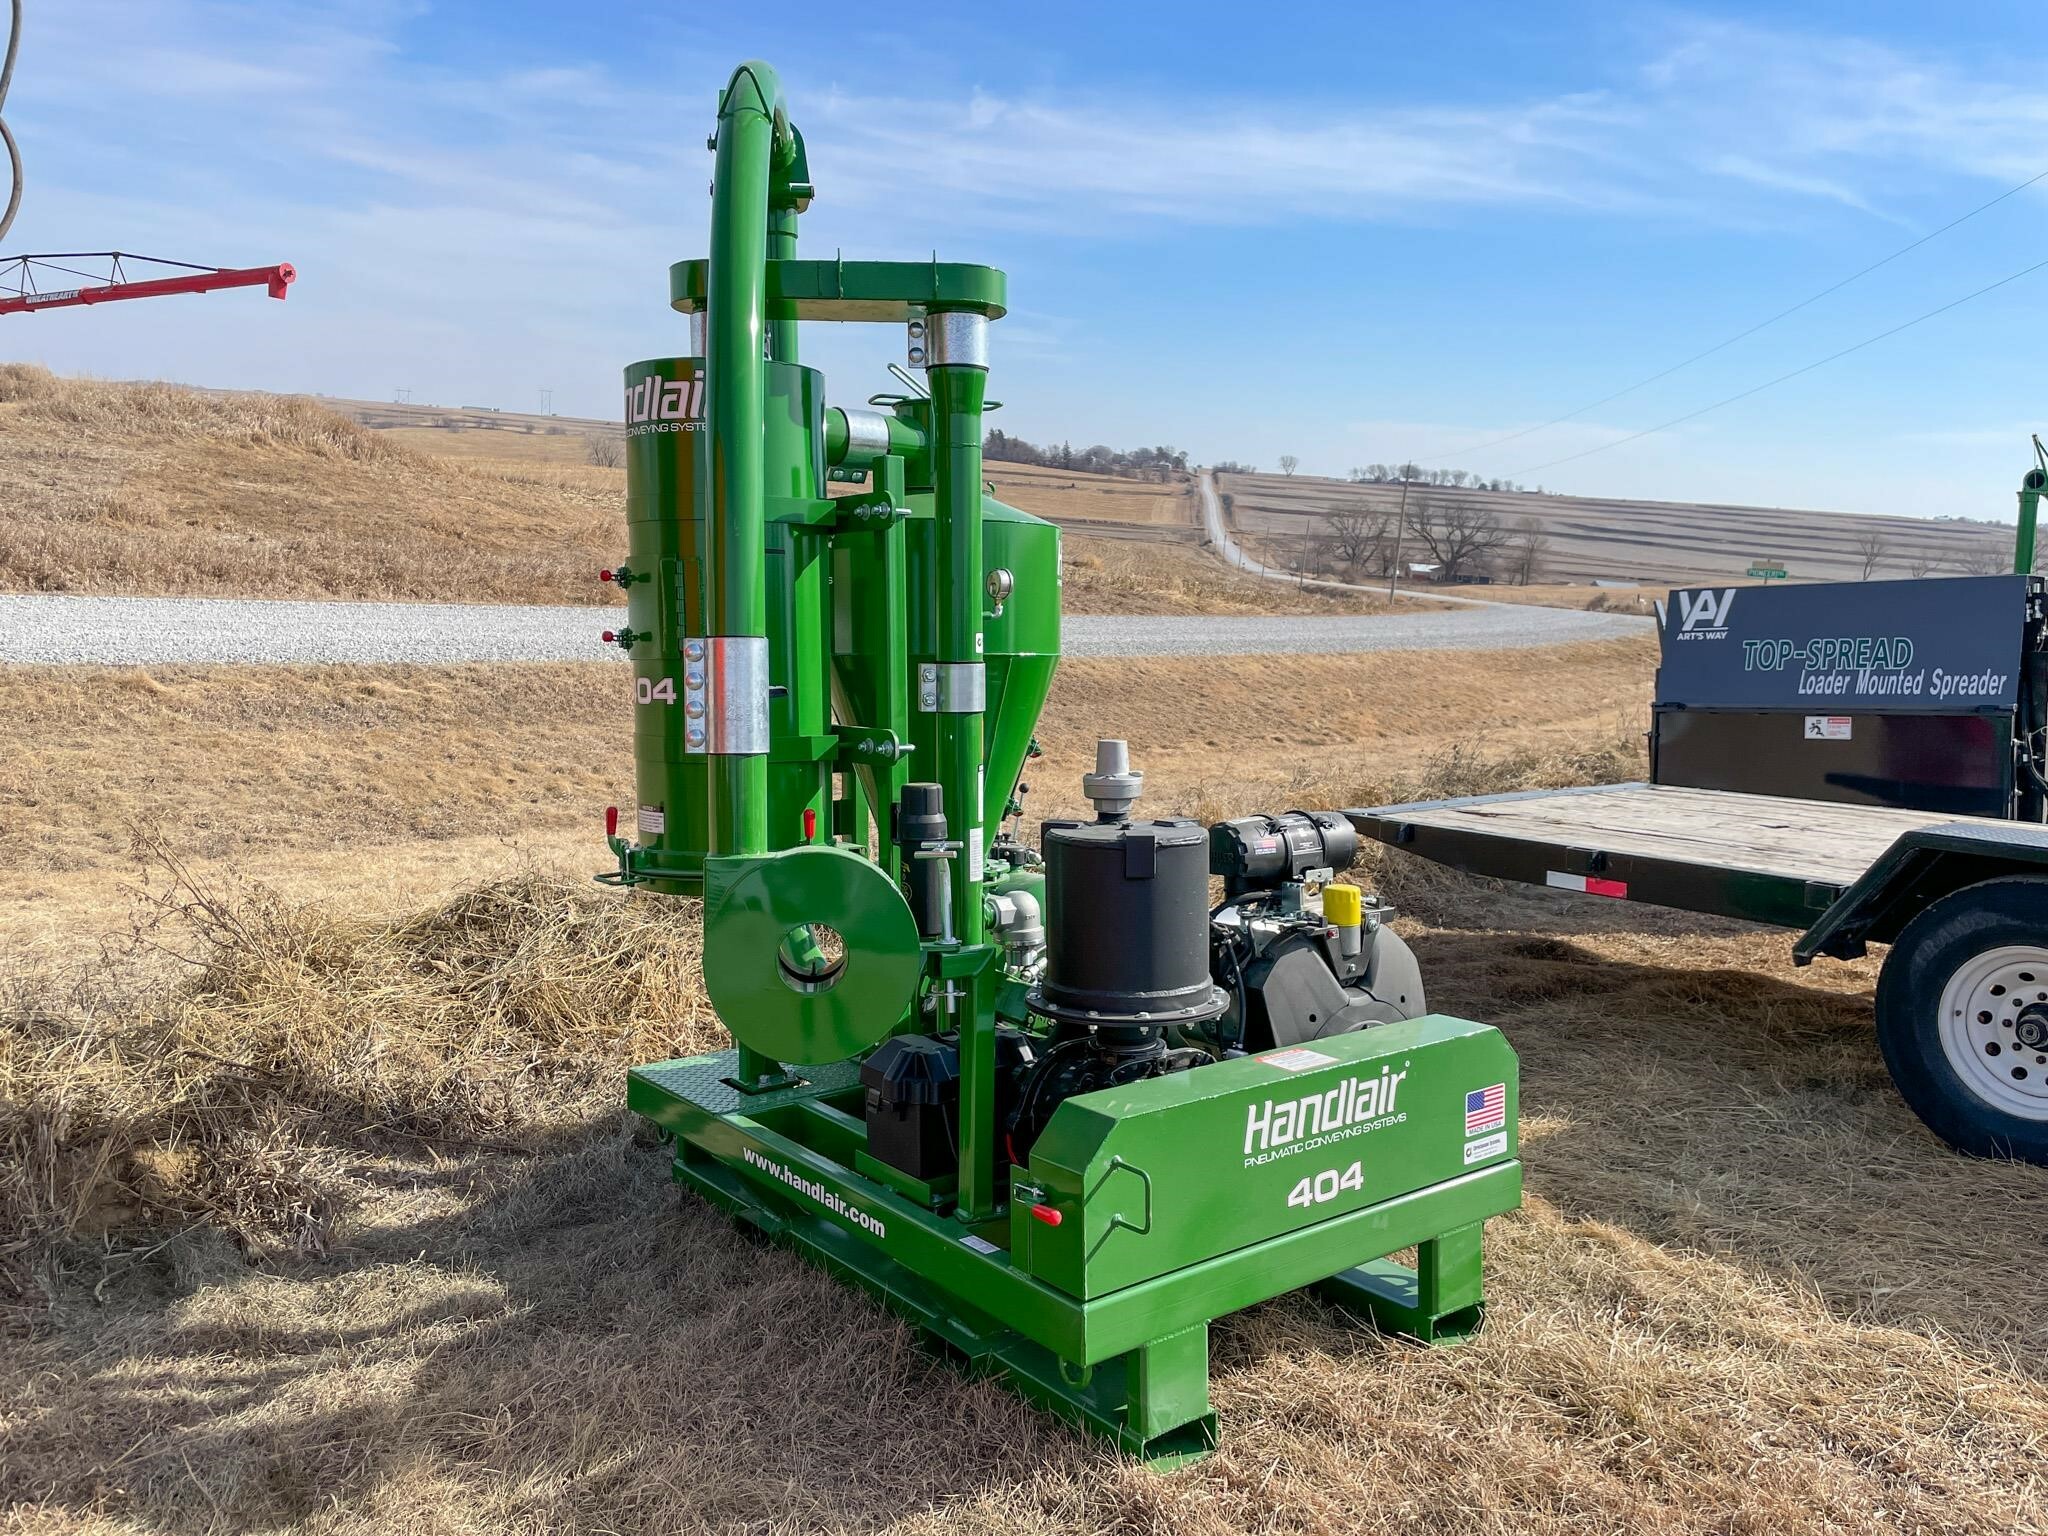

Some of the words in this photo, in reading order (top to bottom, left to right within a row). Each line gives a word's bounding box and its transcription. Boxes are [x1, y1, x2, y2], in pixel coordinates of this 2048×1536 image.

[671, 422, 706, 432] SYSTE
[1676, 632, 1704, 641] ART'S
[1705, 631, 1728, 640] WAY
[1742, 637, 1914, 671] TOP-SPREAD
[1798, 669, 1851, 695] Loader
[1855, 668, 1925, 695] Mounted
[1929, 667, 2008, 700] Spreader
[1243, 1065, 1407, 1154] Handlair
[1244, 1143, 1304, 1168] PNEUMATIC
[1305, 1126, 1362, 1151] CONVEYING
[1363, 1113, 1407, 1133] SYSTEMS
[1469, 1126, 1484, 1134] MADE
[1491, 1120, 1502, 1128] USA
[743, 1147, 886, 1239] www.handlair.com
[1287, 1161, 1364, 1208] 404
